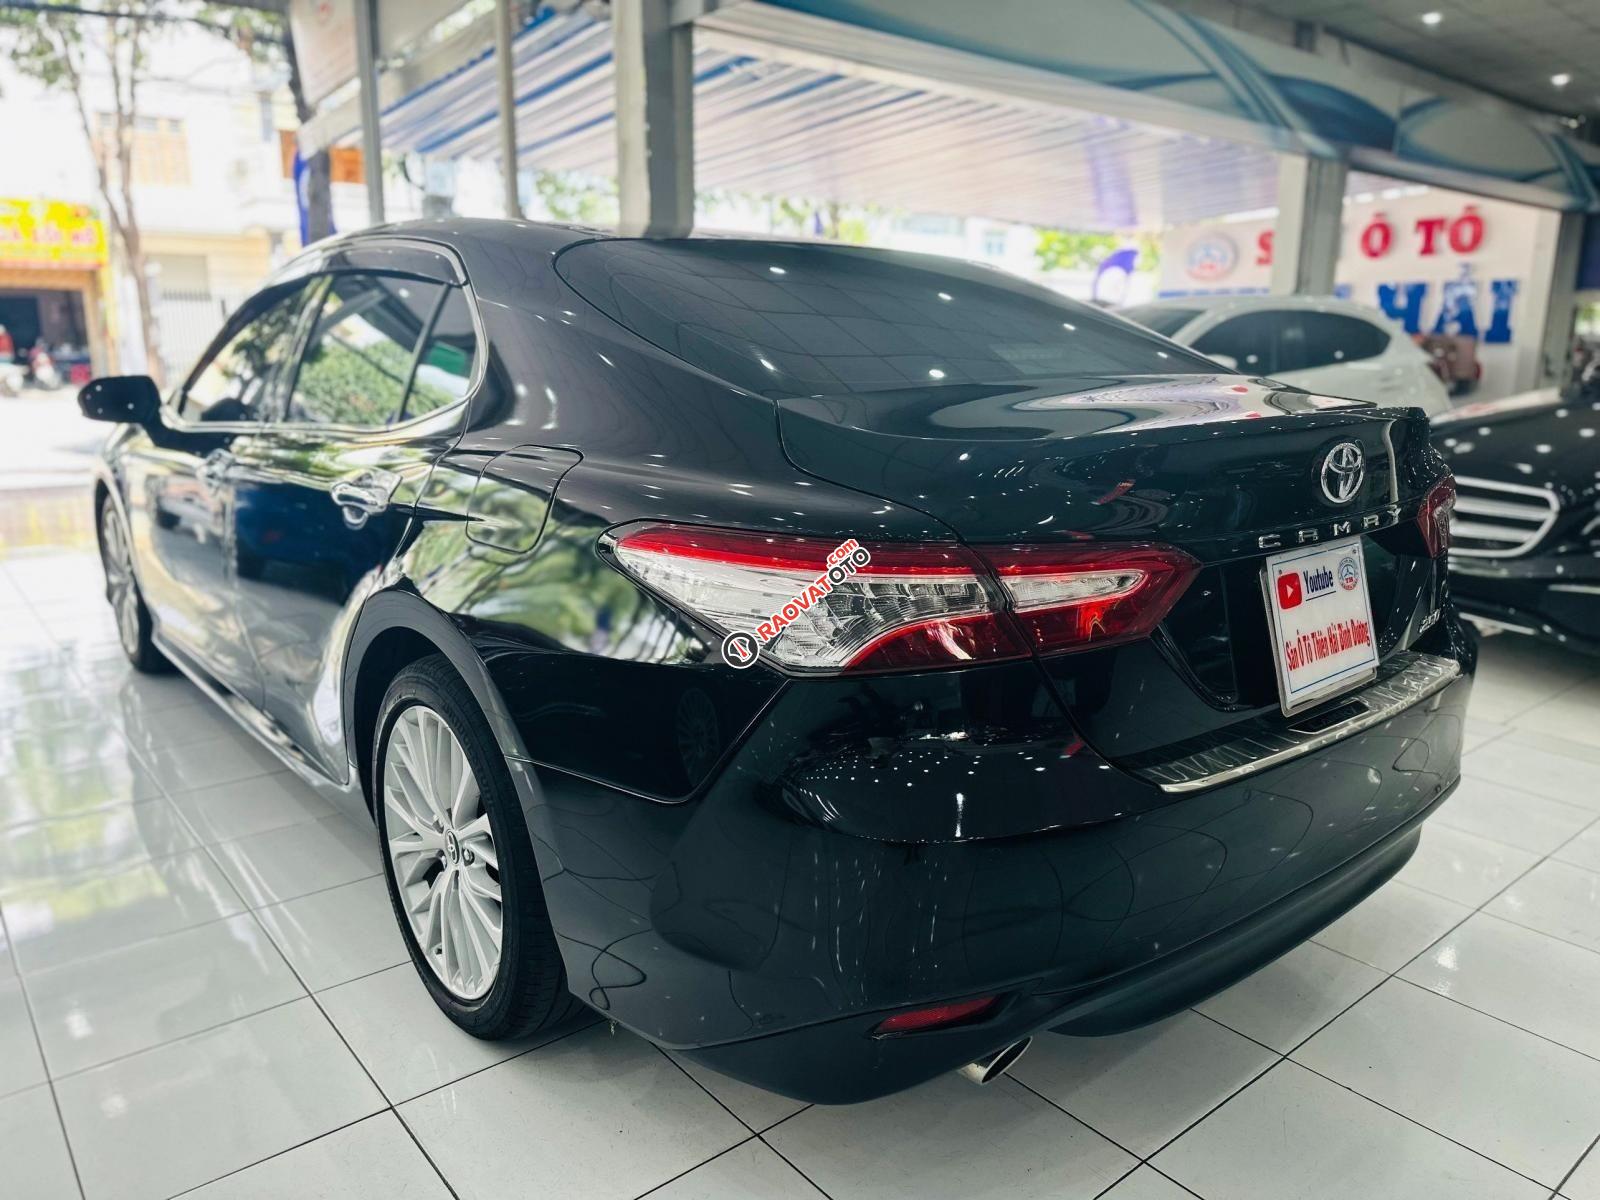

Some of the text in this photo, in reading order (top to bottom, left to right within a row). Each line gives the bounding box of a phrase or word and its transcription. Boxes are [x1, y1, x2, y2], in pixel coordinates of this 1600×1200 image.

[1360, 204, 1486, 260] Ô TÔ
[1258, 507, 1401, 548] CAMRY
[1302, 566, 1334, 594] Youtube
